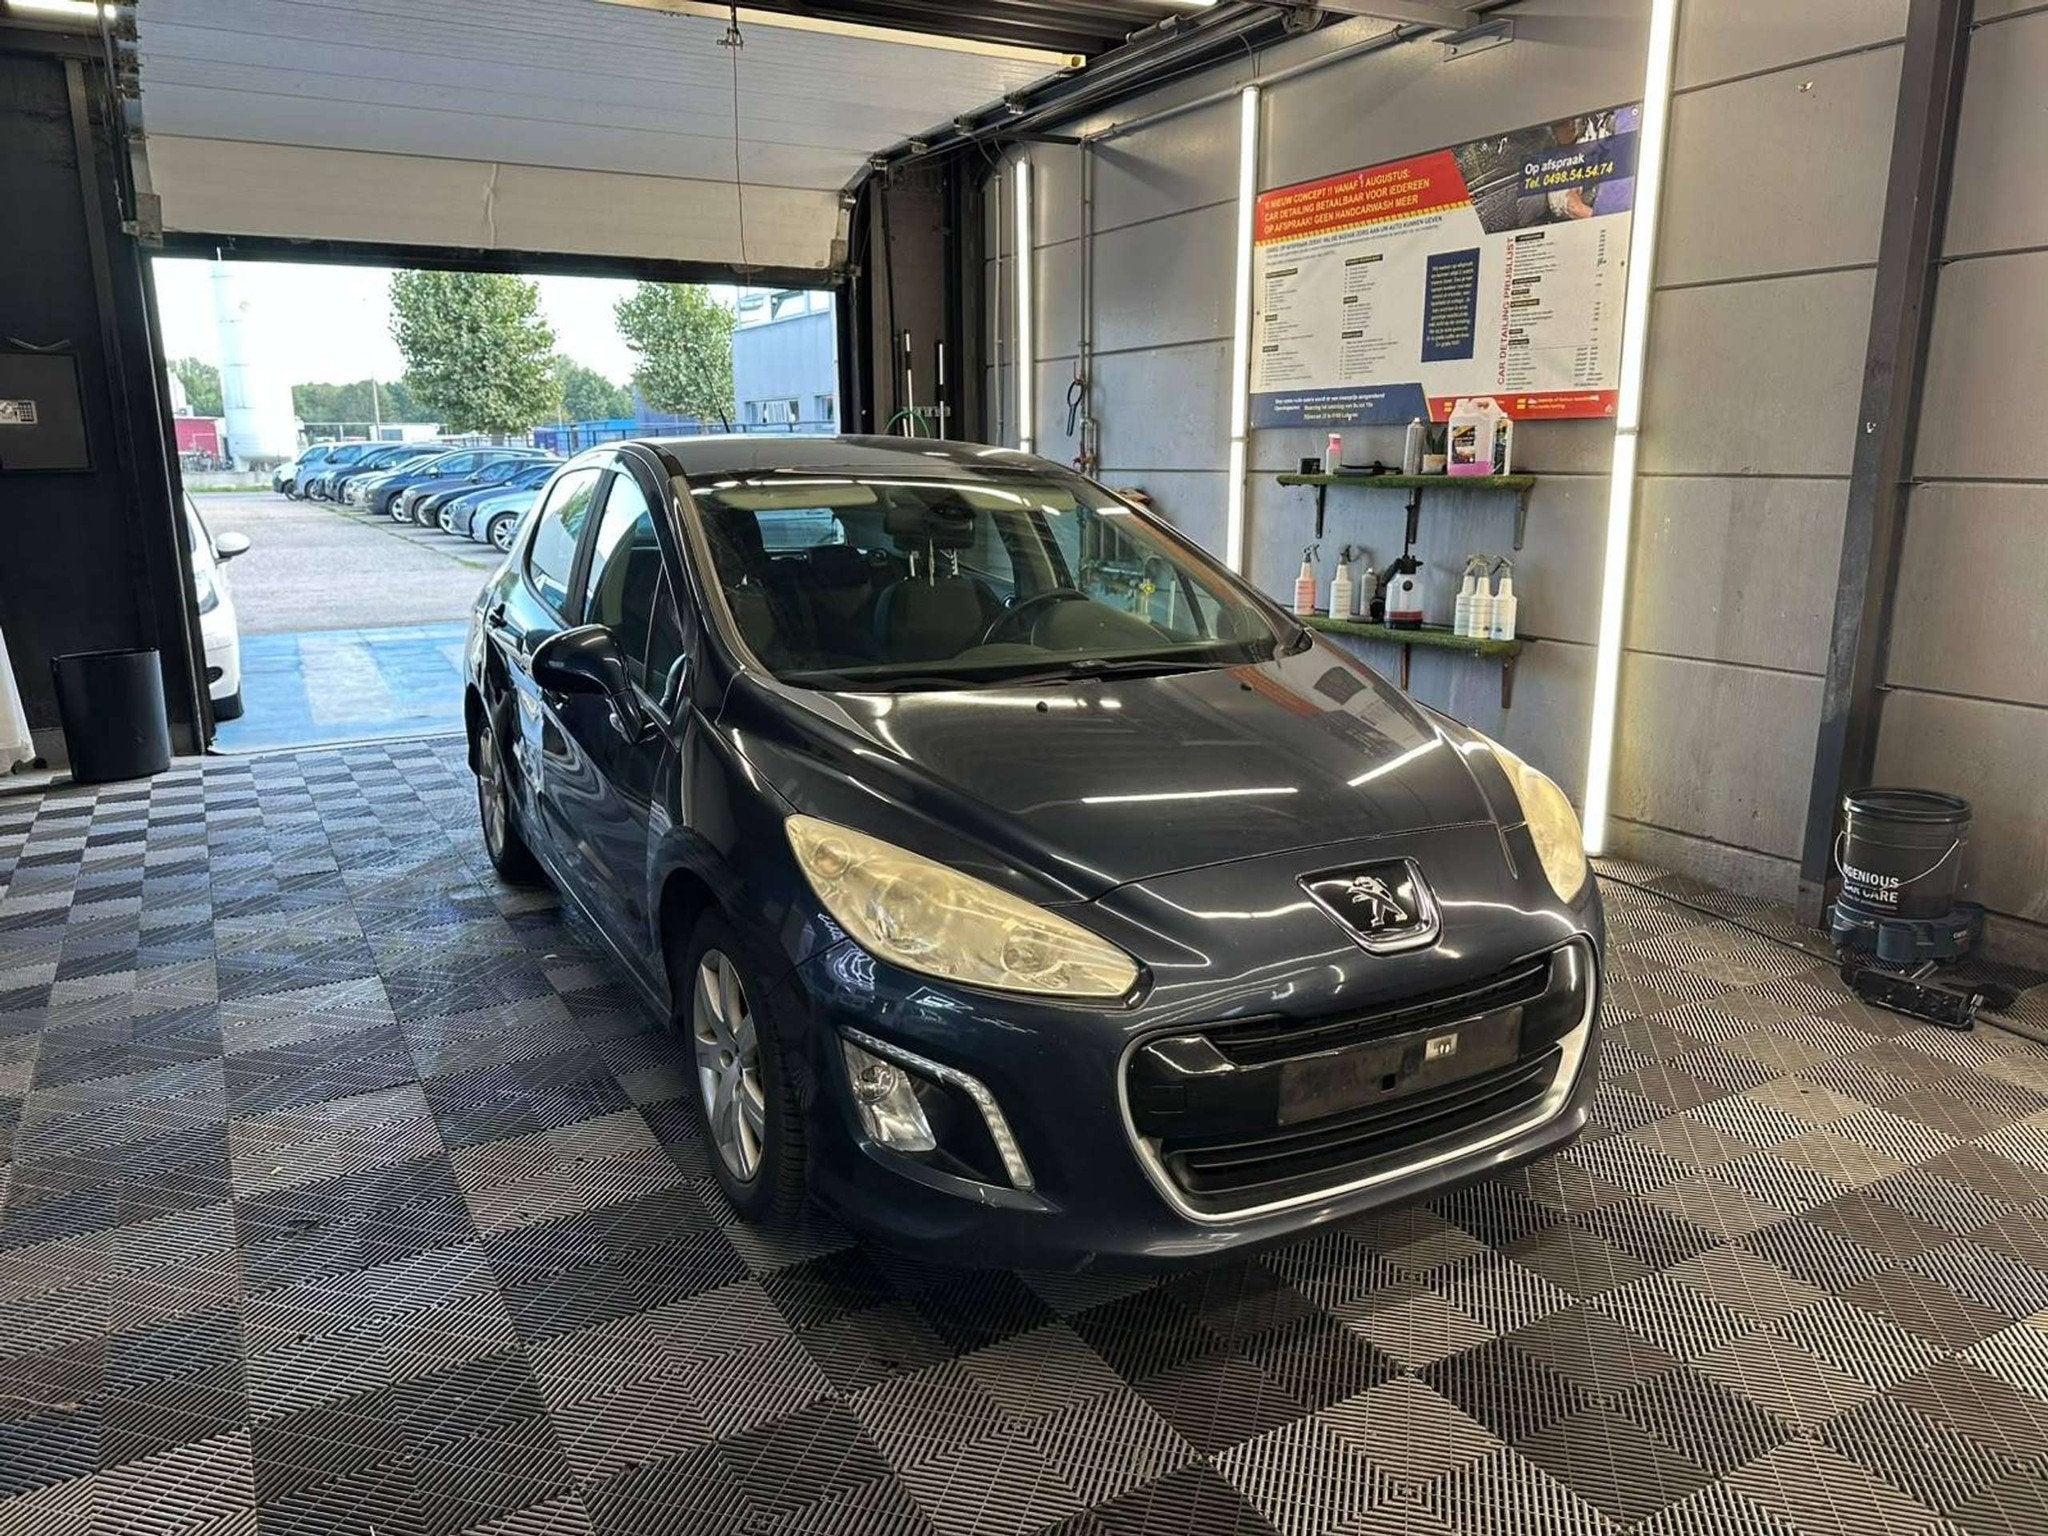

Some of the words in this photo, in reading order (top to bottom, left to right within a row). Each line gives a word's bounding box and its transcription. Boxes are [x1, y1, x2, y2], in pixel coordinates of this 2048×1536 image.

[1525, 163, 1539, 176] Op
[1541, 153, 1585, 172] afspraak
[1293, 189, 1327, 204] CONCEPT
[1334, 180, 1359, 195] VANAF
[1525, 177, 1540, 190] Tel.
[1264, 210, 1279, 222] CAR
[1279, 204, 1315, 219] DETAILING
[1315, 192, 1364, 213] BETAALBAAR
[1365, 186, 1388, 200] VOOR
[1389, 179, 1430, 196] IEDEREEN
[1264, 224, 1275, 234] OP
[1314, 212, 1334, 226] GEEN
[1335, 200, 1394, 222] HANDCARWASH
[1395, 194, 1419, 208] MEER
[1499, 301, 1510, 359] DETAILING
[1497, 362, 1506, 385] CAR
